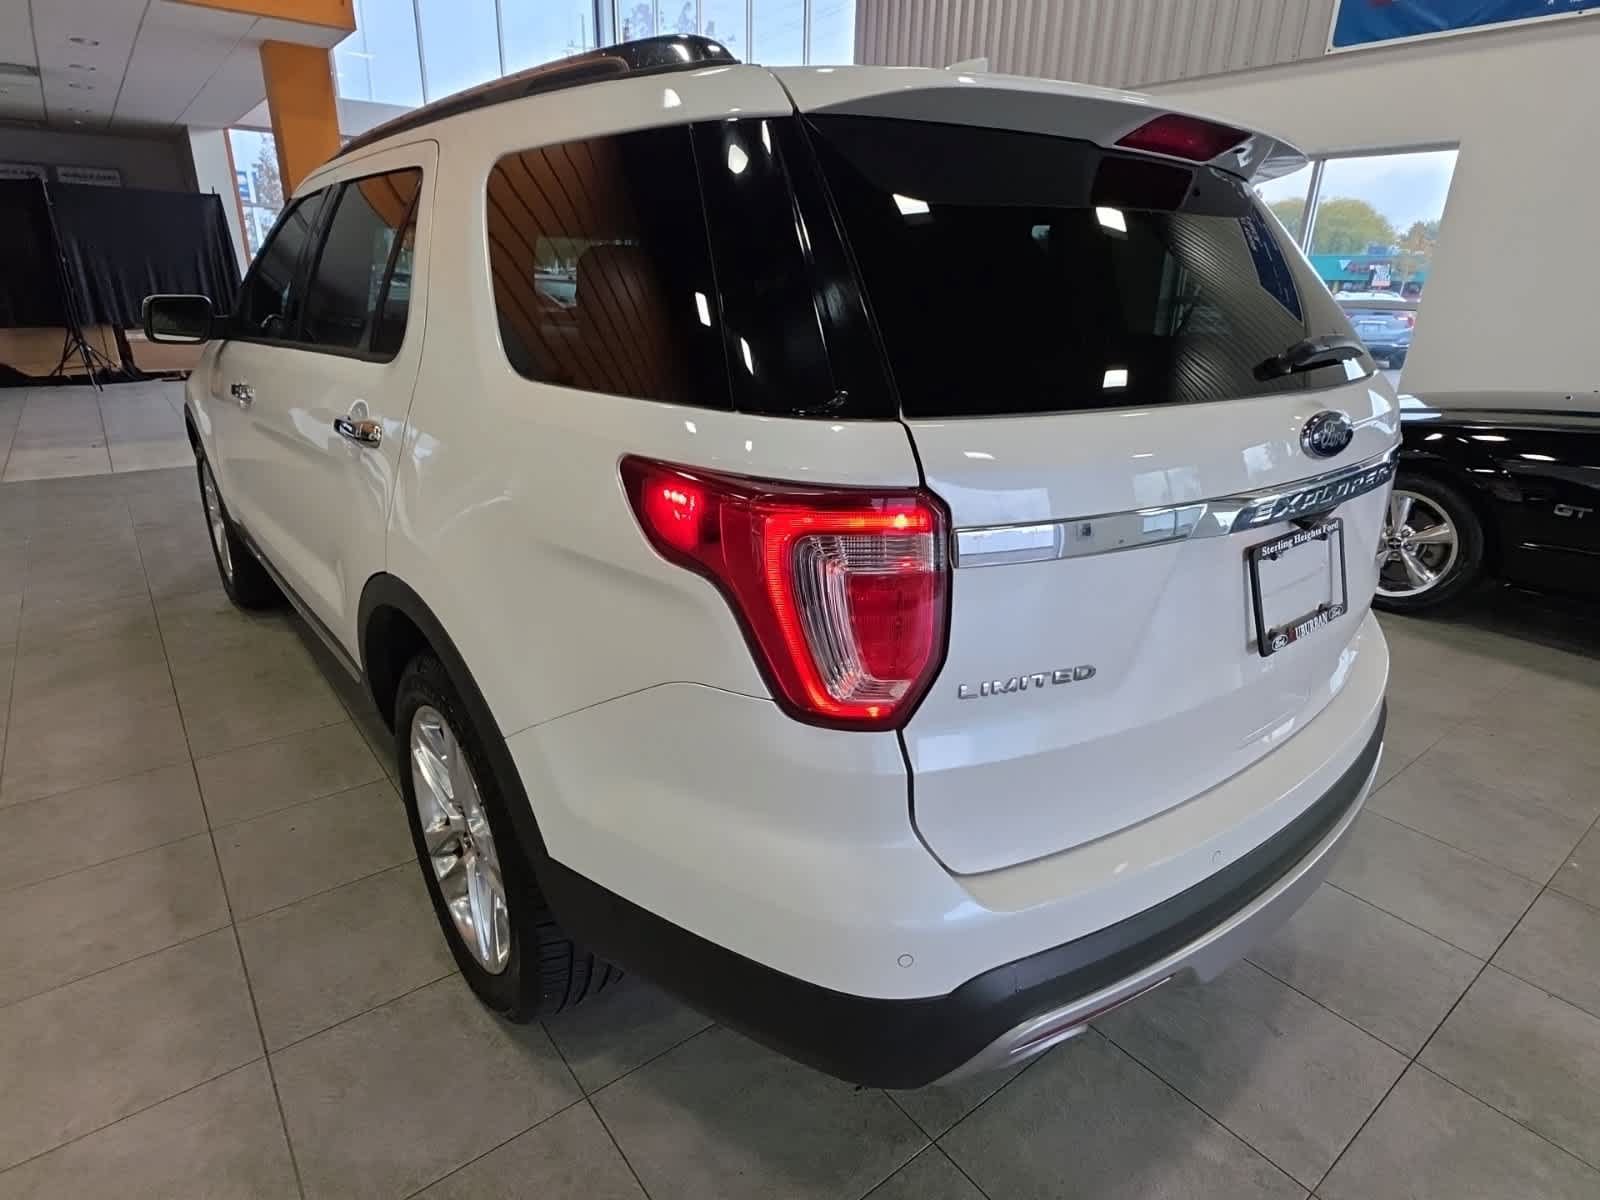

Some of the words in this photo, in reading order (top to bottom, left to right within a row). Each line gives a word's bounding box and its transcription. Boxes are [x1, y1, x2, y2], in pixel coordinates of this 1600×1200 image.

[1553, 503, 1593, 519] GT
[1261, 539, 1294, 557] Sterling
[1293, 528, 1322, 543] Heights
[1322, 519, 1339, 534] Ford
[1288, 611, 1328, 641] UBURBAN
[958, 664, 1097, 700] LIMITED
